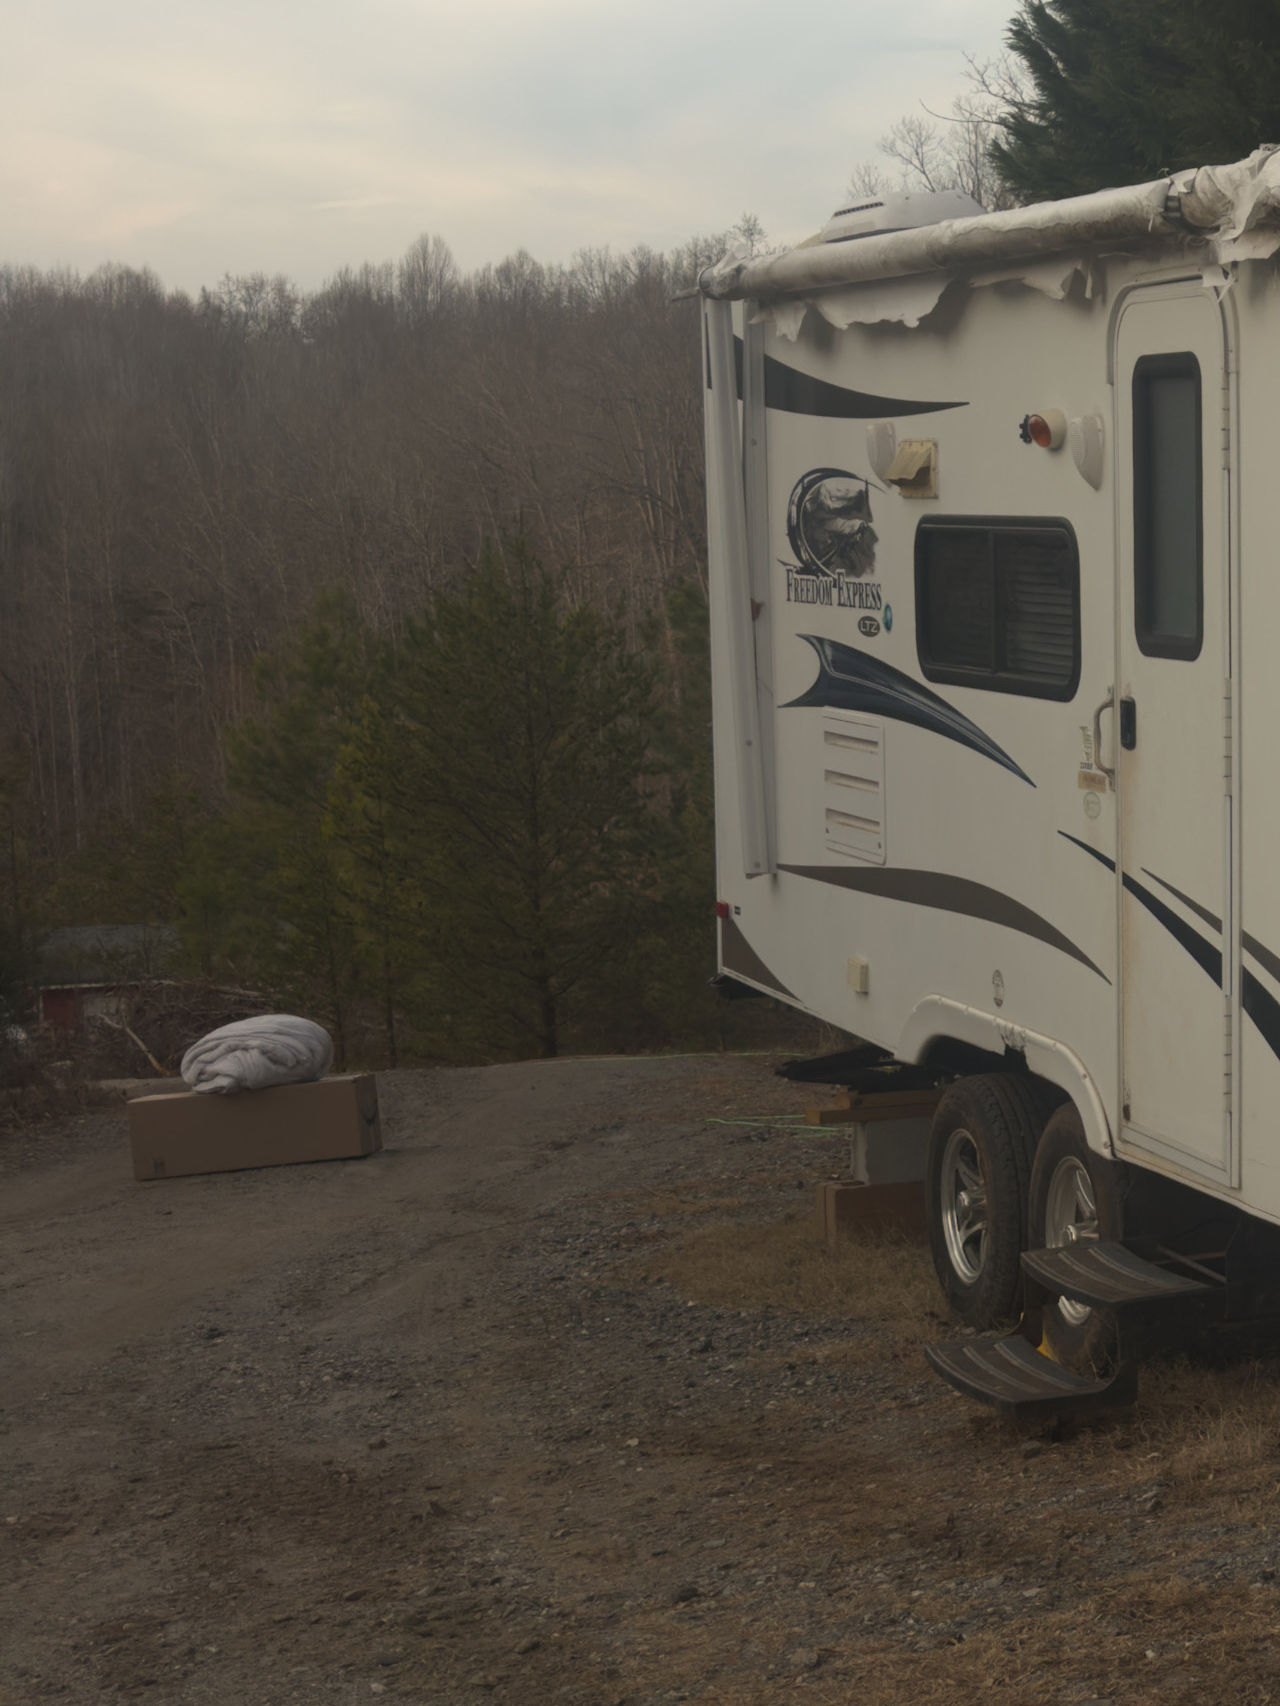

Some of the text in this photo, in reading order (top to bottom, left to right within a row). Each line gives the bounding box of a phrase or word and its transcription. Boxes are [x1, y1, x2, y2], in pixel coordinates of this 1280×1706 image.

[786, 568, 882, 611] FREEDOM EXPRESS
[860, 620, 879, 633] LTZ
